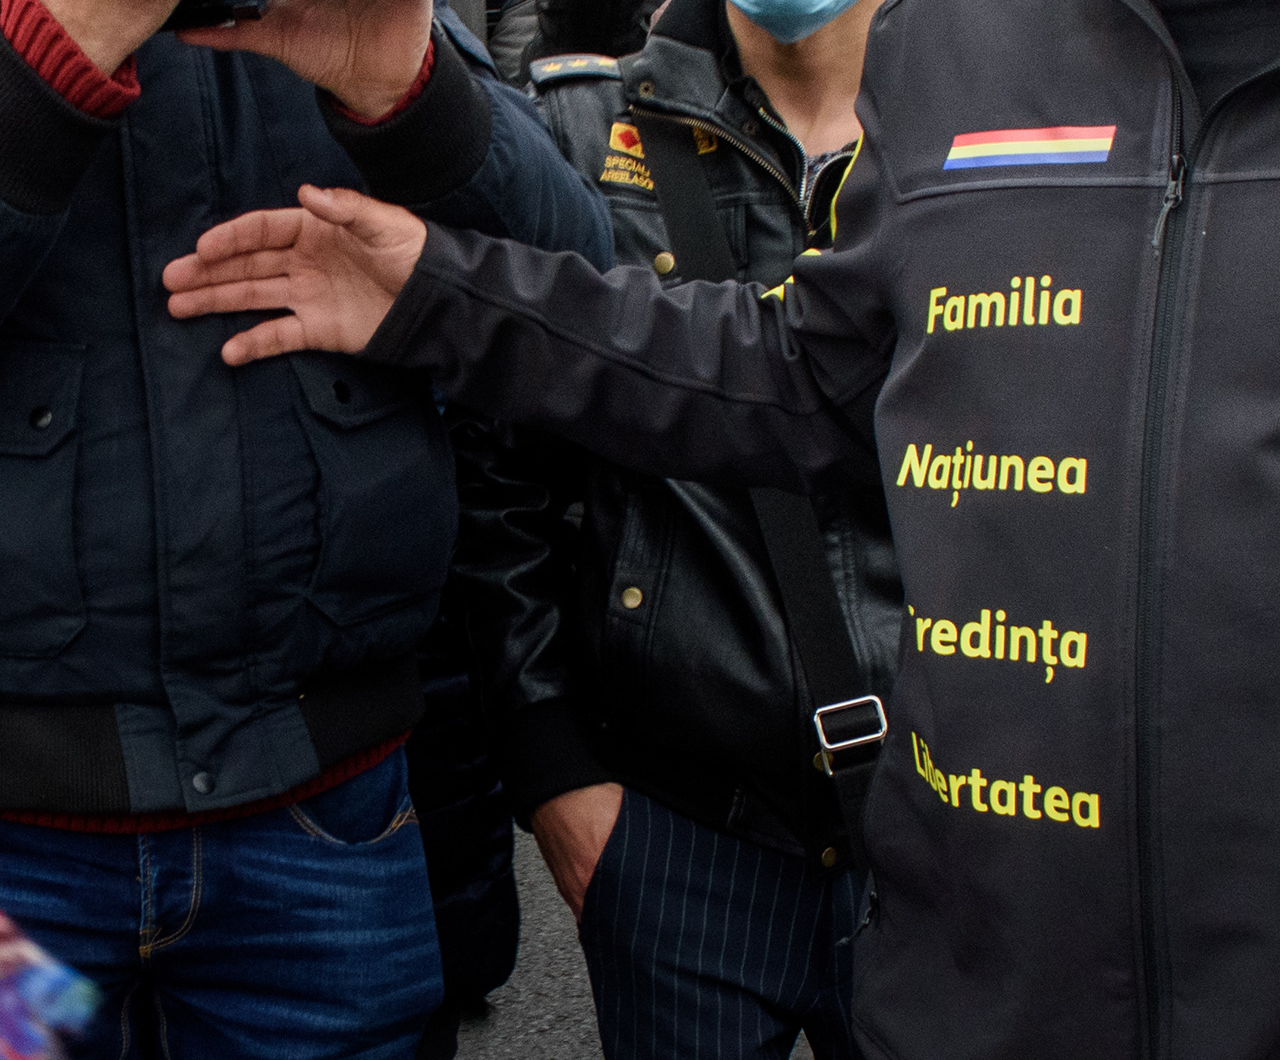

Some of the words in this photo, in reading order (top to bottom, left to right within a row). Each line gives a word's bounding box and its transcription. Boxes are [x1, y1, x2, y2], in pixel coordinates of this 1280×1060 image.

[926, 274, 1082, 334] Familia
[896, 440, 1088, 508] Națiunea
[908, 605, 1088, 684] redința
[911, 731, 1101, 829] Libertatea
